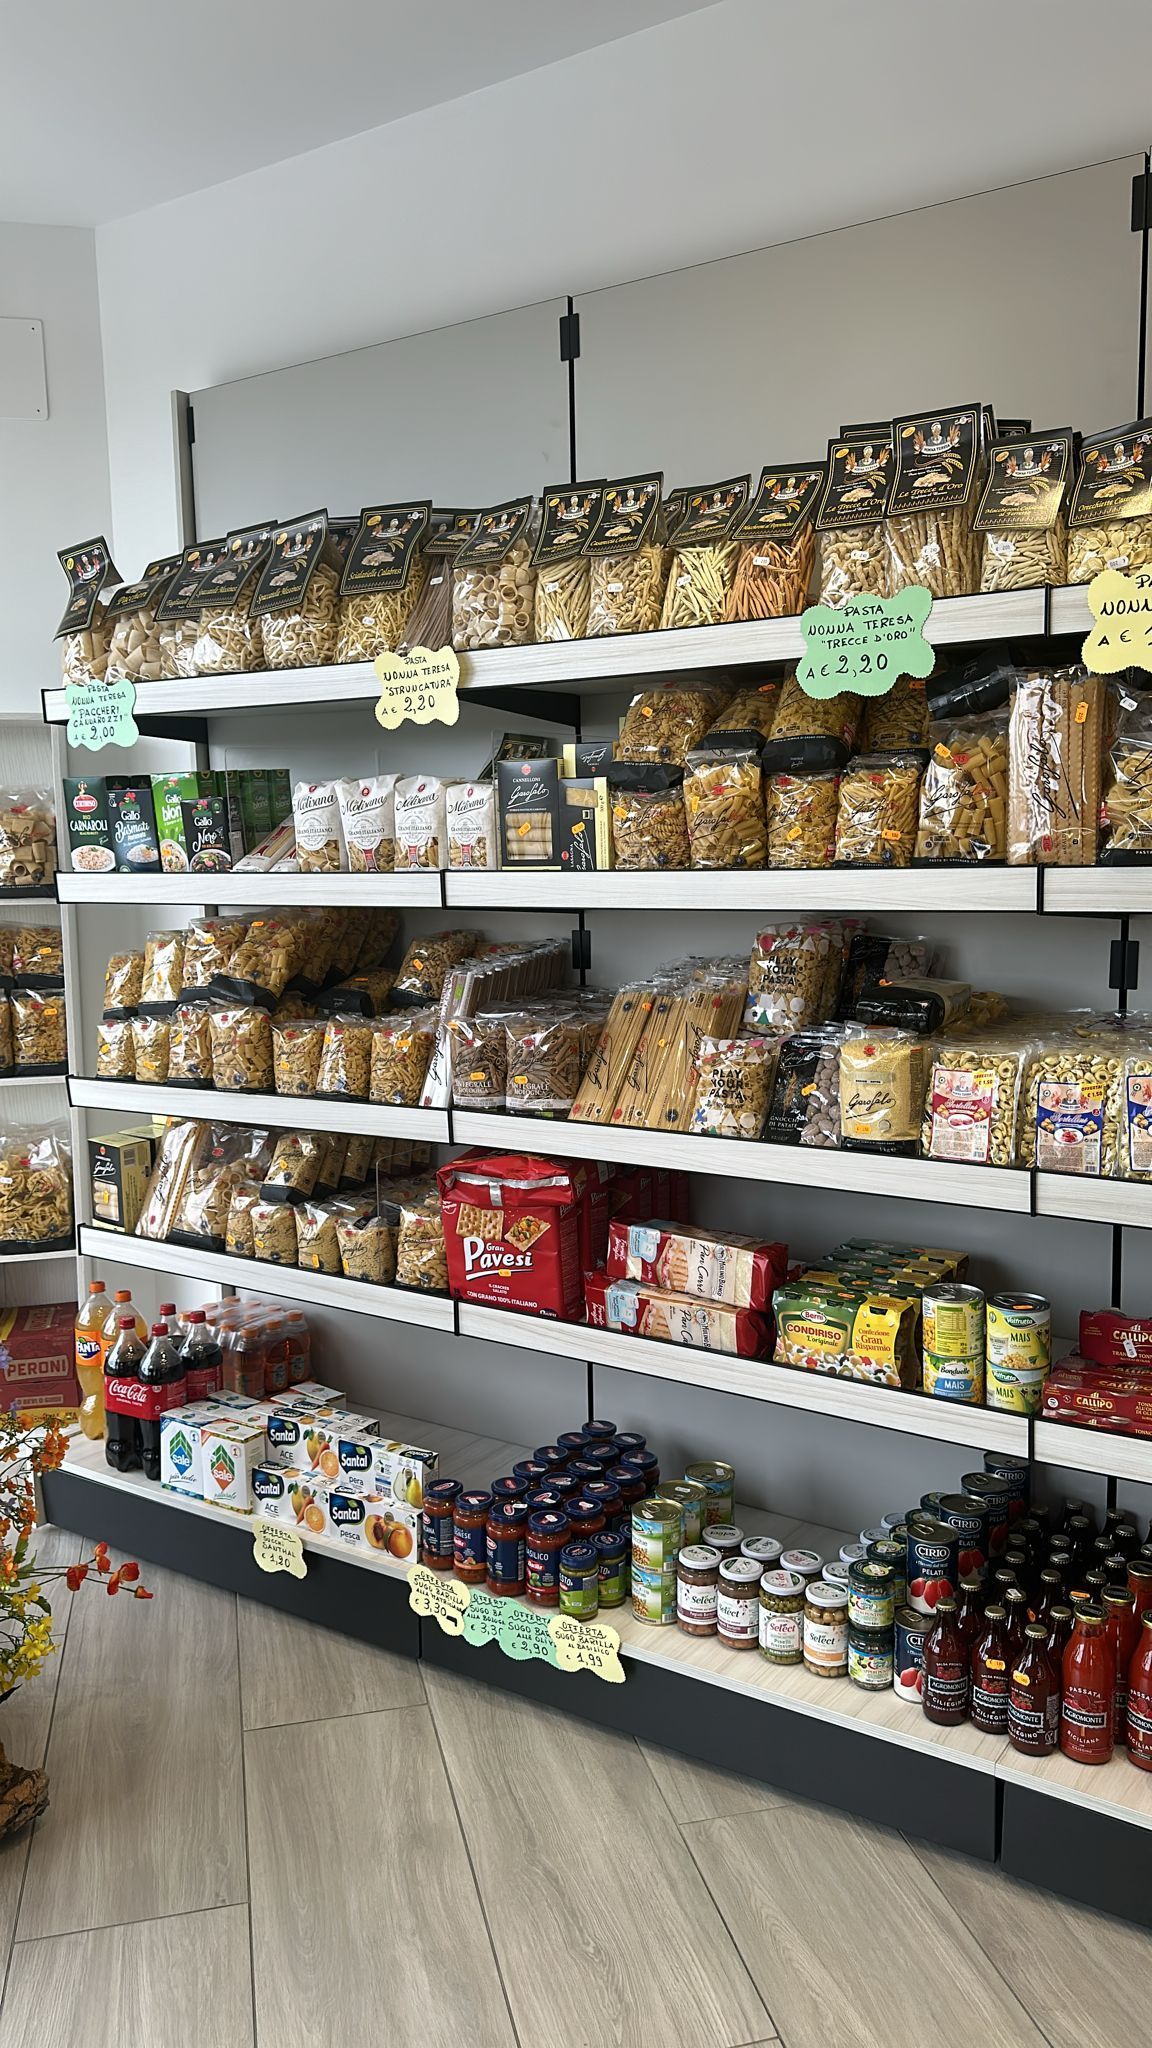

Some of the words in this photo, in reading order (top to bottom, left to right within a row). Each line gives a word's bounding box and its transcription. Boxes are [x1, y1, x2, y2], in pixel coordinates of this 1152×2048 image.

[843, 605, 884, 617] PASTA
[808, 622, 855, 636] NONNA
[863, 614, 914, 630] TERESA
[1098, 635, 1110, 646] A
[1120, 629, 1131, 642] €
[404, 656, 427, 665] PASTA
[806, 668, 815, 679] A
[820, 664, 830, 677] €
[835, 653, 888, 678] 2,20
[384, 669, 418, 682] NONNA
[421, 663, 450, 676] TERESA
[87, 684, 109, 693] PASTA
[99, 691, 126, 702] TERESA
[382, 707, 388, 715] A
[404, 694, 435, 714] 2,20
[90, 725, 115, 742] 2,00
[165, 795, 182, 804] Gallo
[121, 810, 140, 821] Gallo
[161, 806, 182, 821] blon
[70, 819, 108, 831] CARNAROLI
[194, 816, 213, 827] Gallo
[115, 821, 150, 843] Basmati
[768, 955, 796, 965] PLAY
[766, 965, 797, 975] YOUR
[762, 974, 797, 986] PASTA
[712, 1069, 742, 1079] PLAY
[711, 1080, 744, 1090] YOUR
[709, 1088, 745, 1102] PASTA
[846, 1091, 897, 1113] Garofalo
[463, 1236, 533, 1271] Pavesi
[486, 1242, 505, 1252] Gran
[699, 1244, 710, 1265] Pan
[466, 1290, 478, 1298] CON
[478, 1293, 497, 1301] GRANO
[511, 1298, 538, 1308] ITALIANO
[805, 1311, 824, 1321] Berni
[786, 1323, 842, 1341] CONDIRISO
[858, 1328, 890, 1337] Confezione
[1010, 1332, 1031, 1342] MAIS
[807, 1335, 839, 1347] L'originale
[861, 1334, 883, 1345] Gran
[77, 1341, 100, 1353] FANTA
[855, 1342, 891, 1352] Risparmio
[7, 1359, 67, 1377] PERONI
[941, 1366, 971, 1376] Bonduelle
[944, 1380, 965, 1389] MAIS
[995, 1387, 1014, 1398] MAIS
[1075, 1396, 1113, 1409] CALLIPO
[270, 1429, 296, 1442] Santal
[172, 1454, 190, 1467] sale
[280, 1450, 294, 1460] ACE
[341, 1453, 368, 1468] Santal
[213, 1469, 232, 1482] sale
[349, 1477, 364, 1487] pera
[255, 1481, 280, 1495] Santal
[265, 1503, 279, 1514] ACE
[332, 1508, 360, 1521] Santal
[951, 1518, 979, 1529] CIRIO
[340, 1529, 361, 1542] pesca
[918, 1546, 947, 1558] CIRIO
[270, 1553, 291, 1568] 1,20
[921, 1568, 944, 1576] PELATI
[420, 1570, 455, 1594] OFFERTA
[691, 1595, 717, 1604] Select
[423, 1598, 447, 1617] 3,30
[470, 1604, 489, 1615] SUGO
[508, 1621, 532, 1634] SUGO
[562, 1621, 604, 1637] OFFERTA
[769, 1622, 796, 1633] Select
[555, 1630, 575, 1641] SUGO
[578, 1635, 615, 1650] BARILLA
[809, 1632, 836, 1645] Select
[520, 1640, 549, 1656] 2,90
[576, 1652, 603, 1668] 1,99
[931, 1681, 966, 1691] AGROMONTE
[1069, 1686, 1101, 1700] PASSATA
[1065, 1709, 1103, 1723] AGROMONTE
[1067, 1729, 1100, 1744] SICILIANA
